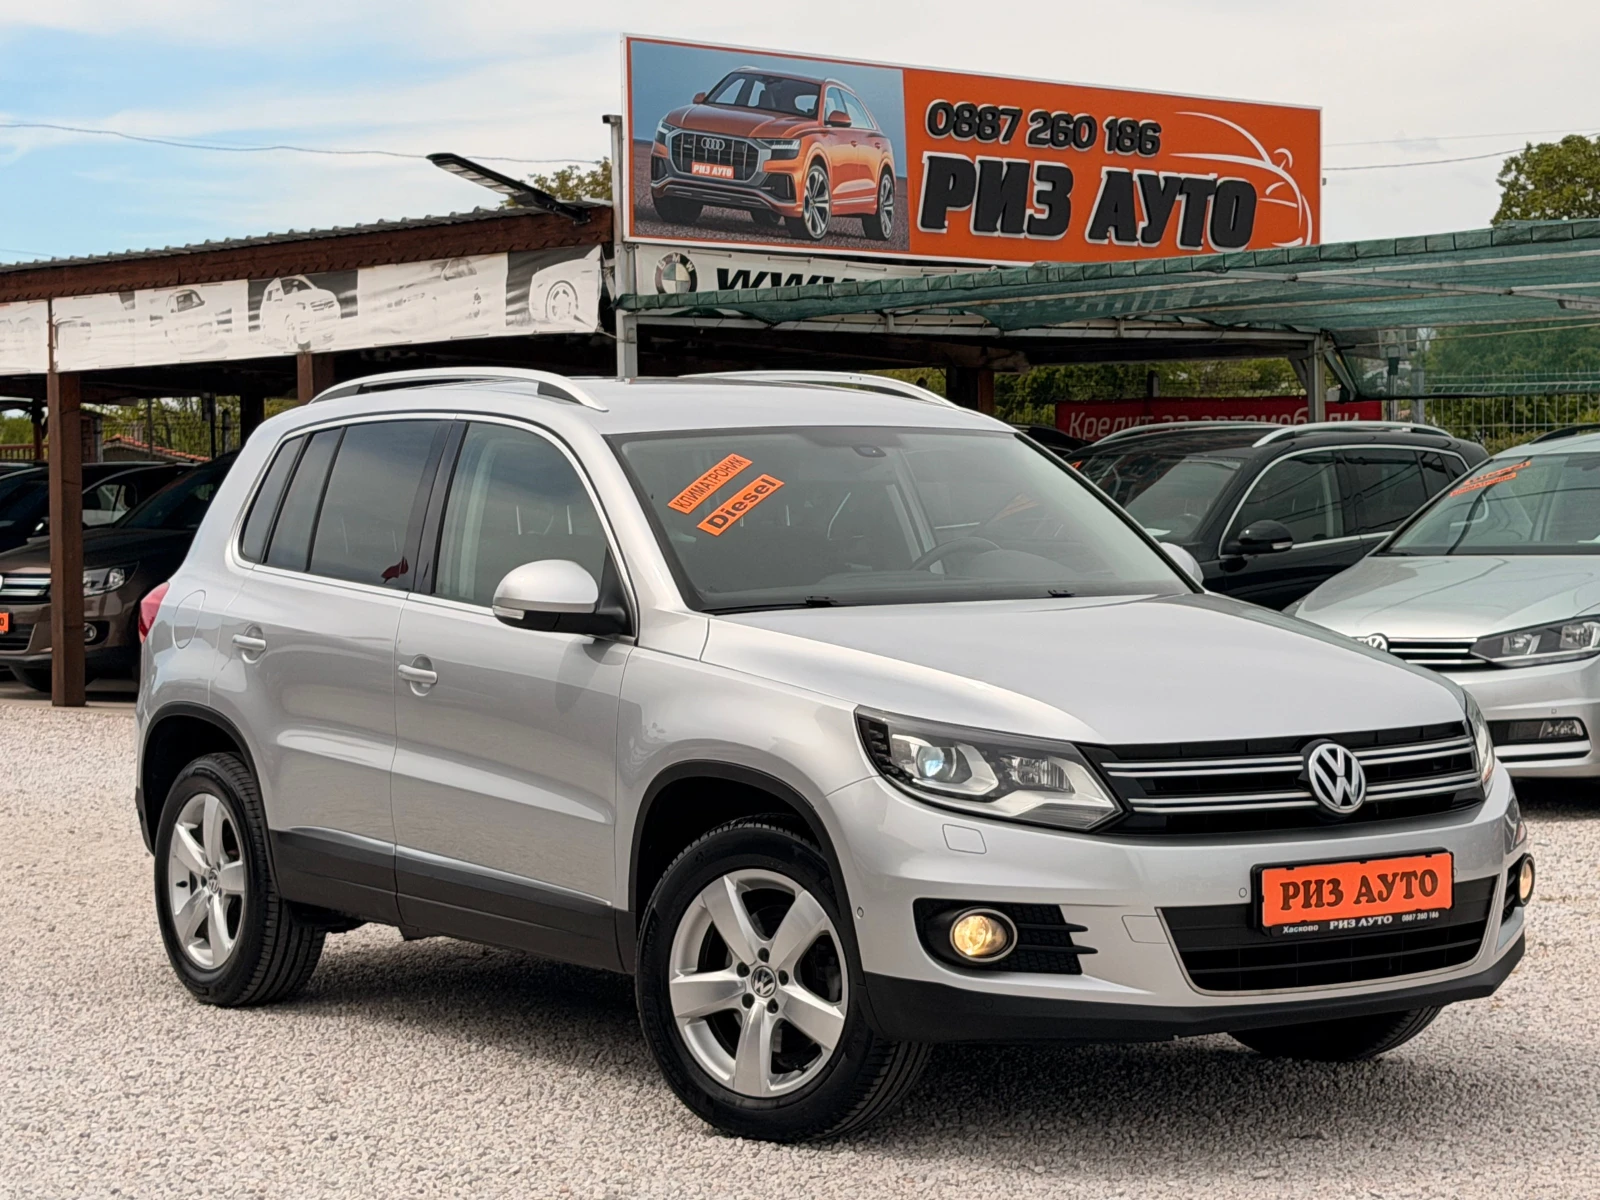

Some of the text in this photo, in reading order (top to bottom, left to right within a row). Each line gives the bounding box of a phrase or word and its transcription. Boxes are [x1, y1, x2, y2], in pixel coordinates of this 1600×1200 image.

[925, 99, 1162, 158] 0887 260 186
[693, 164, 732, 177] РИЗ АУТО
[917, 151, 1257, 251] РИЗ АУТО
[673, 456, 747, 510] КЛИМАТРОНИК
[706, 477, 777, 530] Diesel
[1280, 868, 1439, 911] РИЗ АУТО
[1282, 924, 1319, 934] Хасково
[1329, 919, 1356, 930] РИЗ
[1358, 915, 1393, 928] АУТО
